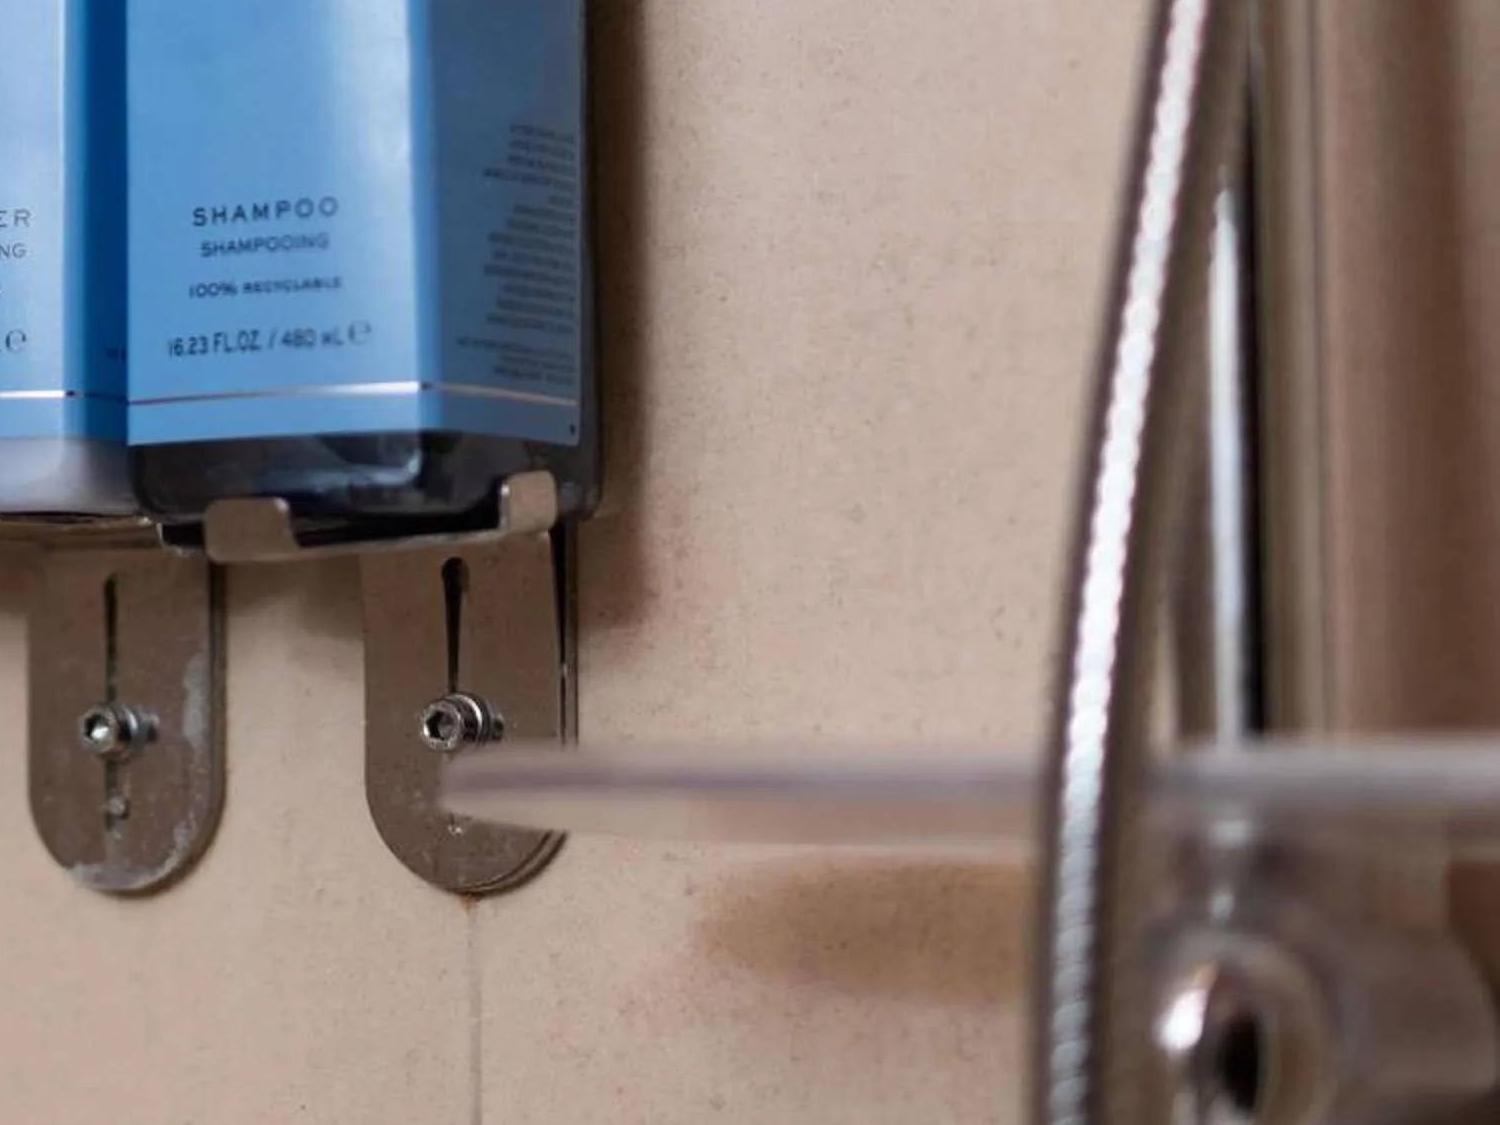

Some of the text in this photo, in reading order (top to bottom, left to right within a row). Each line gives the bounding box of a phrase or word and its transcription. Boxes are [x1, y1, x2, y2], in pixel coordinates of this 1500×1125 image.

[192, 196, 339, 227] SHAMPOO
[200, 232, 330, 258] SHAMPOOING
[189, 276, 343, 299] 100% RECYCLABLE
[168, 336, 209, 357] 16.23
